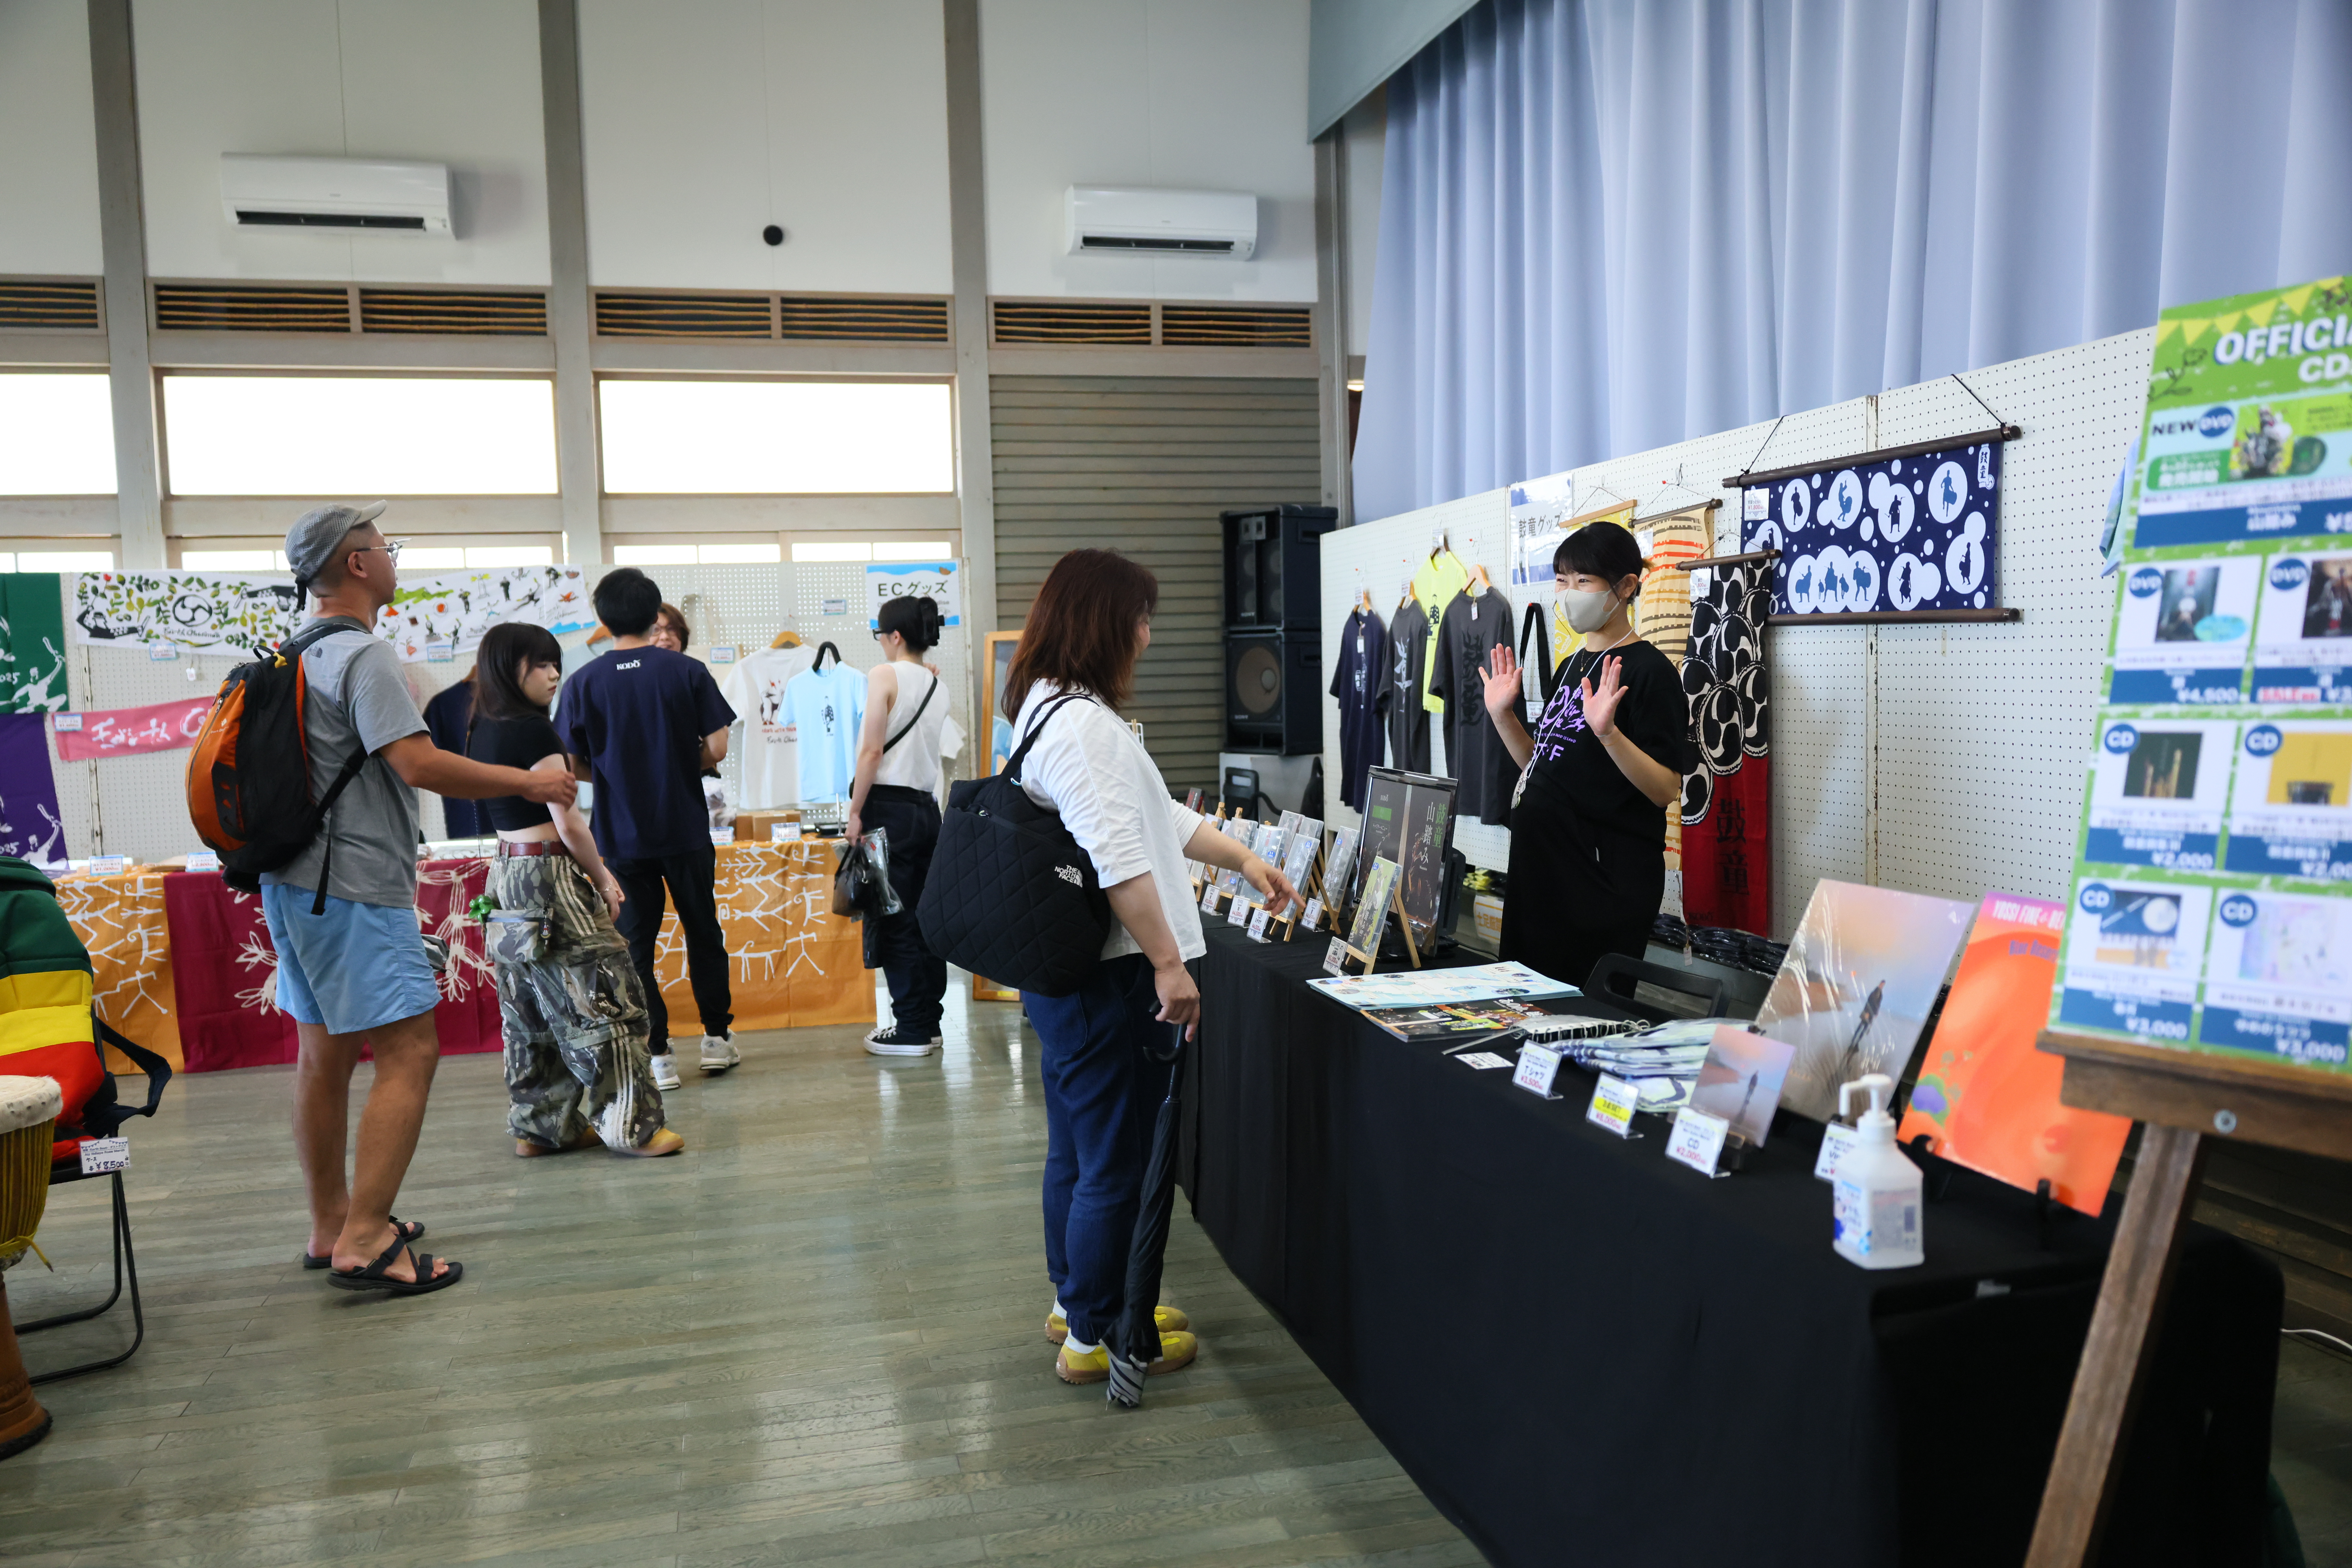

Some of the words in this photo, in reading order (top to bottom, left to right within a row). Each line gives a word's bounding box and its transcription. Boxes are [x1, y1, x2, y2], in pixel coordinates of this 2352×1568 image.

[2152, 420, 2194, 435] NEW
[1519, 511, 1562, 539] 鼓童グッズ
[878, 579, 948, 597] ECグッズ
[2106, 730, 2135, 748] CD
[2246, 732, 2279, 750] CD
[1420, 802, 1435, 864] 山踏み
[1432, 803, 1446, 848] 鼓童
[1715, 799, 1749, 896] 鼓童
[1054, 866, 1076, 878] NORTH
[1059, 873, 1074, 883] FACE
[1066, 865, 1078, 873] THE
[2081, 890, 2110, 908] CD
[1993, 900, 2020, 922] YOSSI
[2018, 905, 2043, 926] FINE
[2222, 902, 2253, 920] CD
[1688, 1138, 1699, 1150] CD
[95, 1161, 124, 1170] ¥8,500
